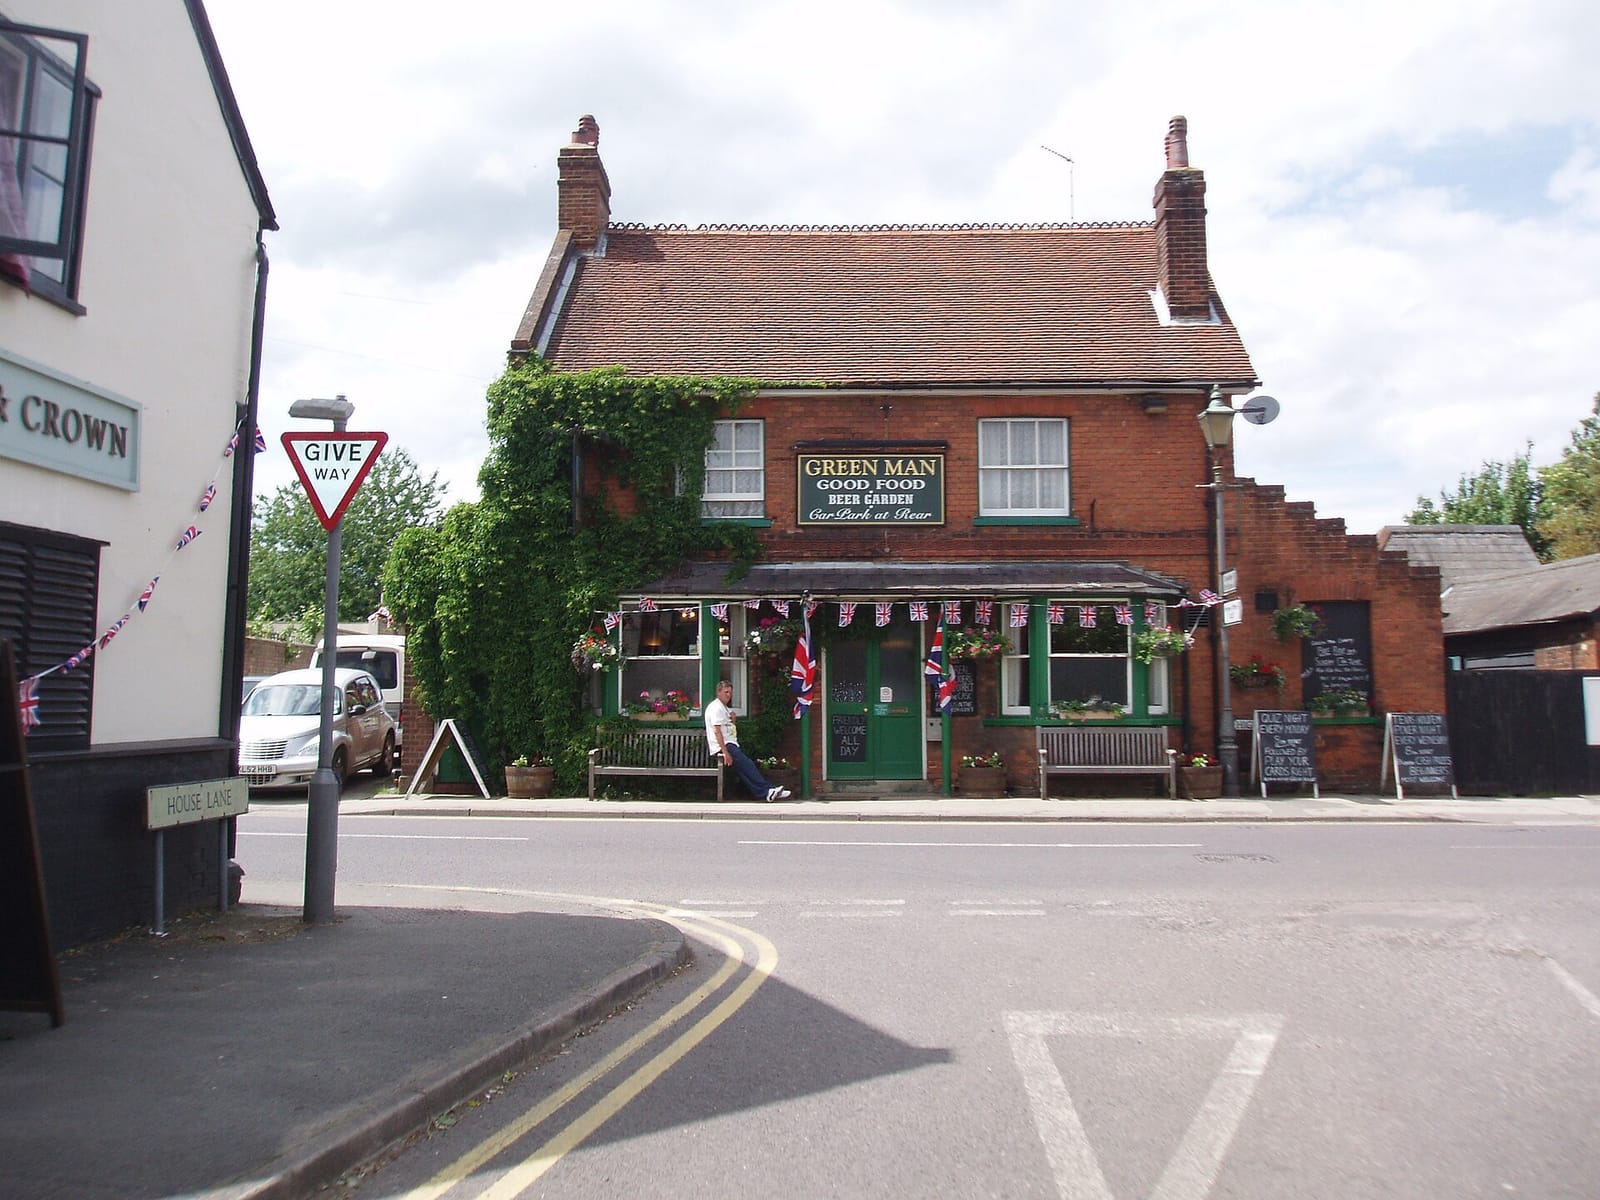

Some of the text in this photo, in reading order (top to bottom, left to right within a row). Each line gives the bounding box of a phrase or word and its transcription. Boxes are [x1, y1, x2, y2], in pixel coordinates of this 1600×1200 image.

[21, 395, 128, 458] CROWN
[305, 443, 362, 461] GIVE
[805, 459, 937, 476] GREEN MAN
[314, 468, 350, 480] WAY
[816, 479, 926, 490] GOOD FOOD
[828, 494, 914, 505] BEER GARDEN
[809, 507, 932, 520] Car Park at Rear
[1261, 713, 1310, 724] QUIZ NIGHT
[833, 726, 867, 735] WELCOME
[1260, 724, 1282, 734] EVERY
[841, 736, 860, 746] ALL
[840, 746, 858, 757] DAY
[1264, 755, 1310, 766] PLAY YOUR
[1264, 766, 1290, 777] CARDS
[167, 789, 232, 815] HOUSE LANE
